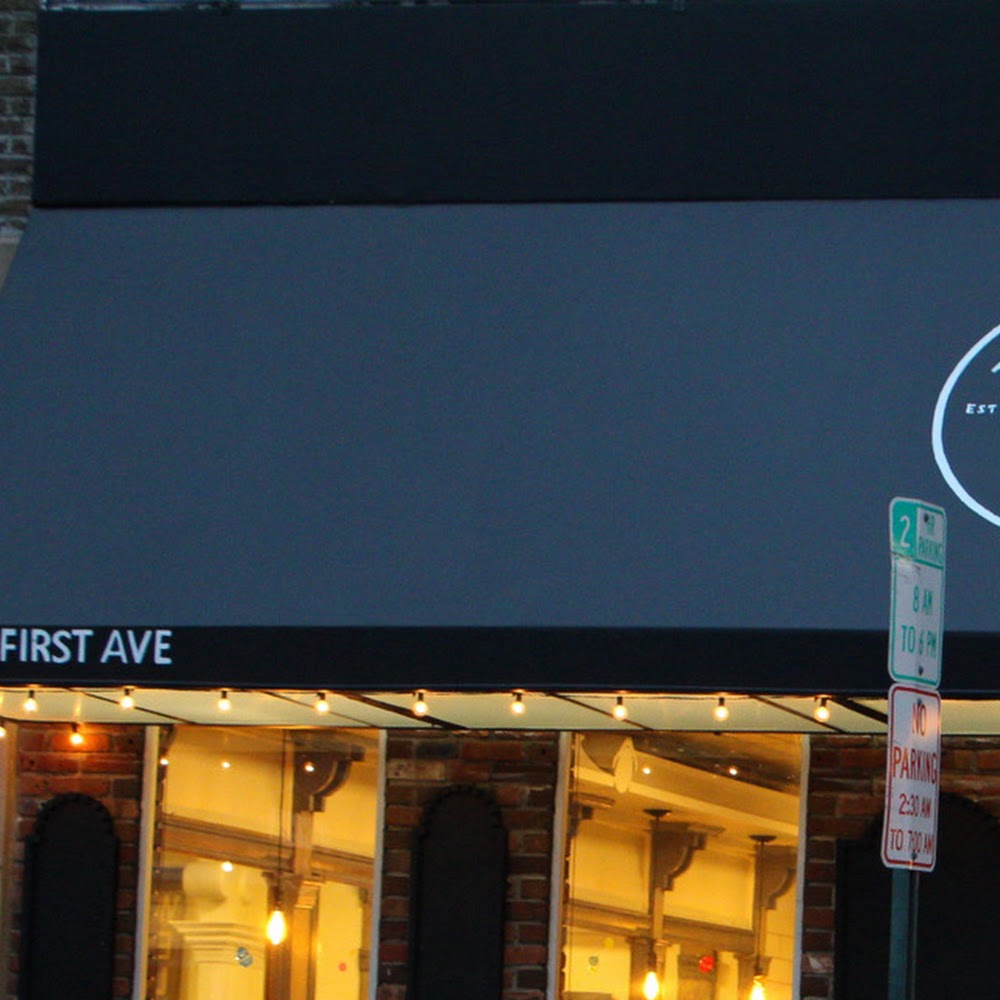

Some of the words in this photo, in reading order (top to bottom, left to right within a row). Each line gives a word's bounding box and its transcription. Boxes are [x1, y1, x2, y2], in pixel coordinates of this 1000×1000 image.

[965, 402, 998, 415] EST
[899, 515, 911, 548] 2
[912, 586, 919, 614] 8
[923, 589, 934, 616] AM
[0, 628, 94, 664] FIRST
[100, 629, 173, 665] AVE
[901, 625, 916, 654] TO
[918, 631, 924, 655] 6
[926, 632, 937, 658] PM
[912, 703, 927, 737] NO
[892, 746, 938, 785] PARKING
[899, 793, 919, 817] 2:30
[921, 798, 931, 819] AM
[890, 829, 904, 851] TO
[923, 834, 934, 855] AM
